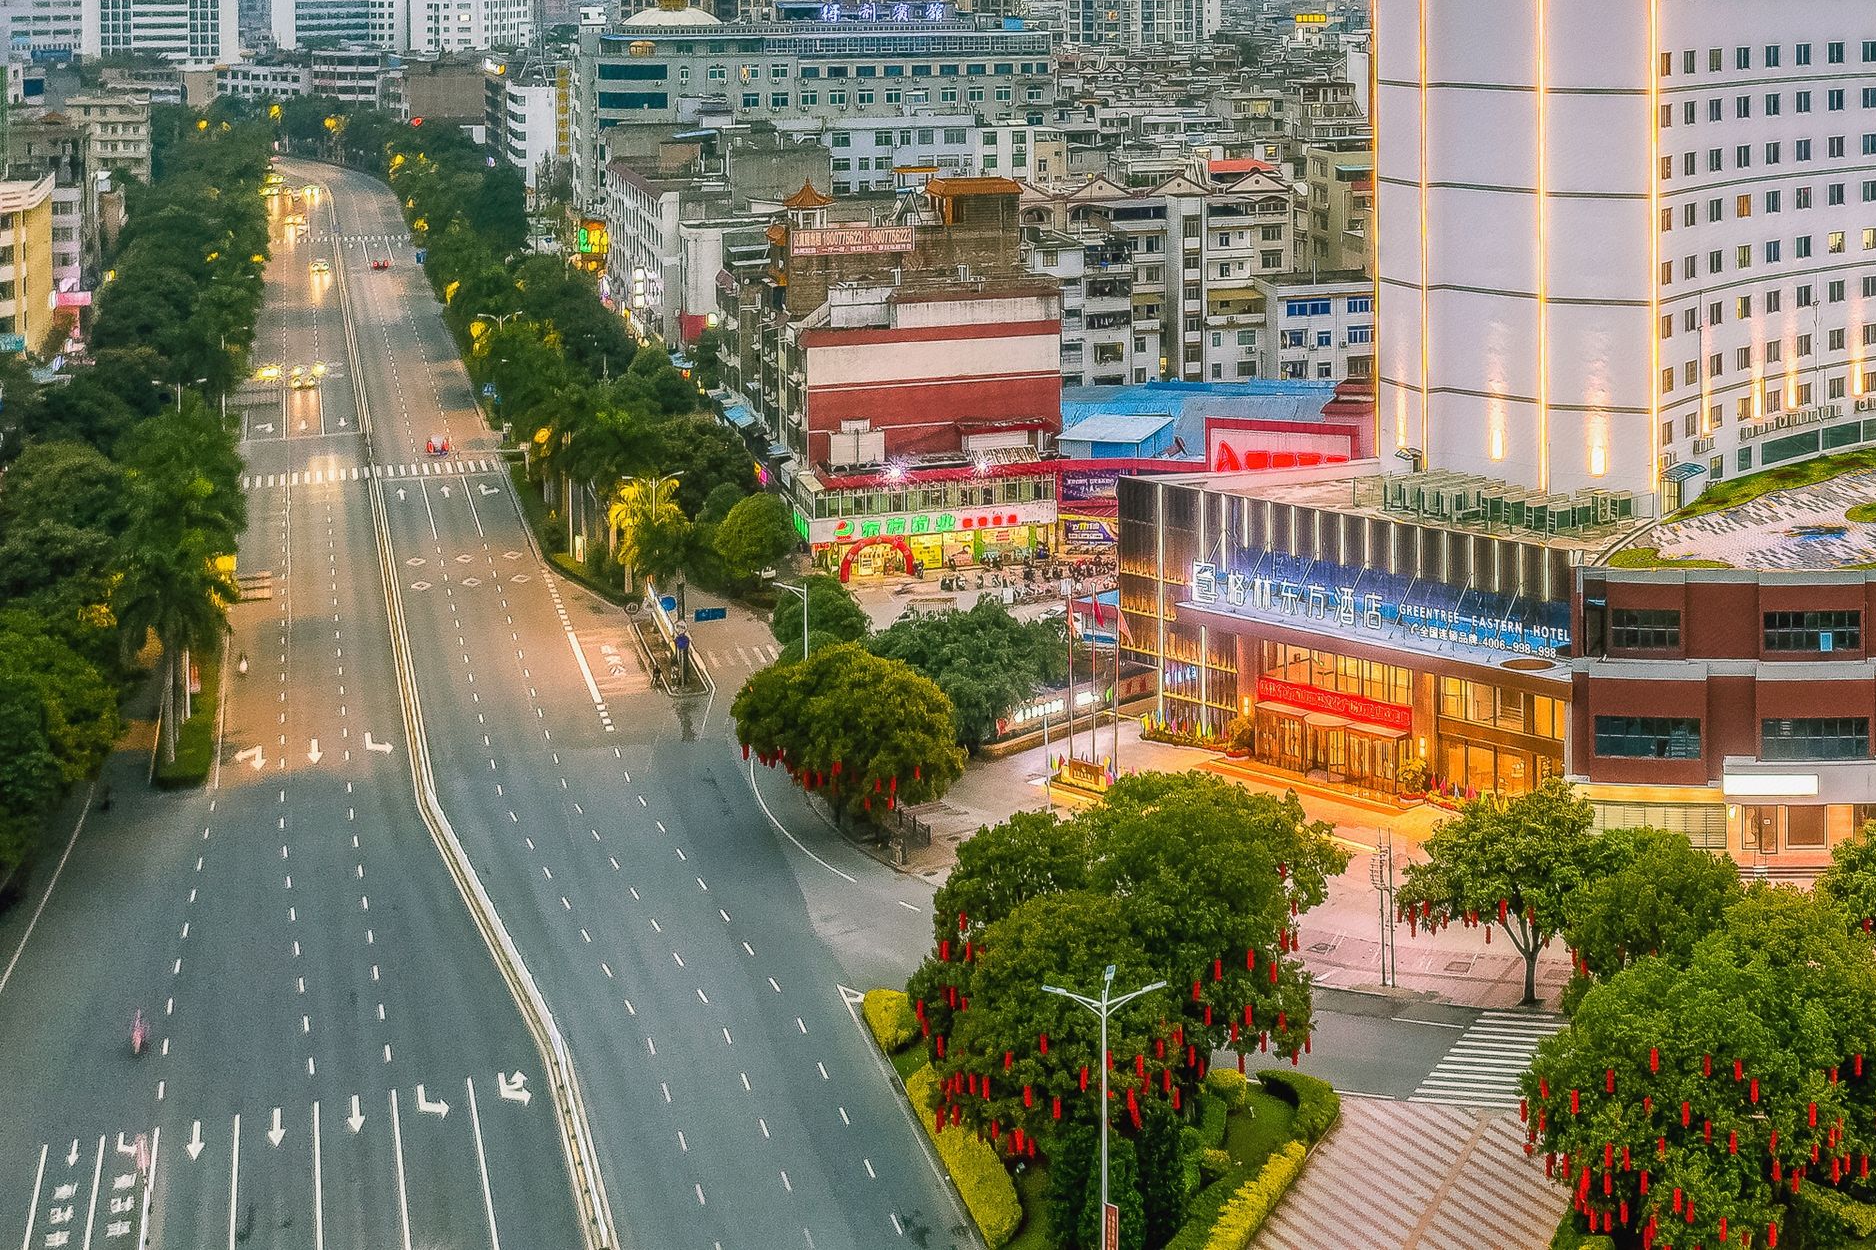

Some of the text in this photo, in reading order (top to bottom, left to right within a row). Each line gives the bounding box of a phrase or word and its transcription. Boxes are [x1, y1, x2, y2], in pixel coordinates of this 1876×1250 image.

[1226, 568, 1383, 630] 格林东方酒店
[1398, 603, 1571, 642] GREENTREE EASTERN HOTEL
